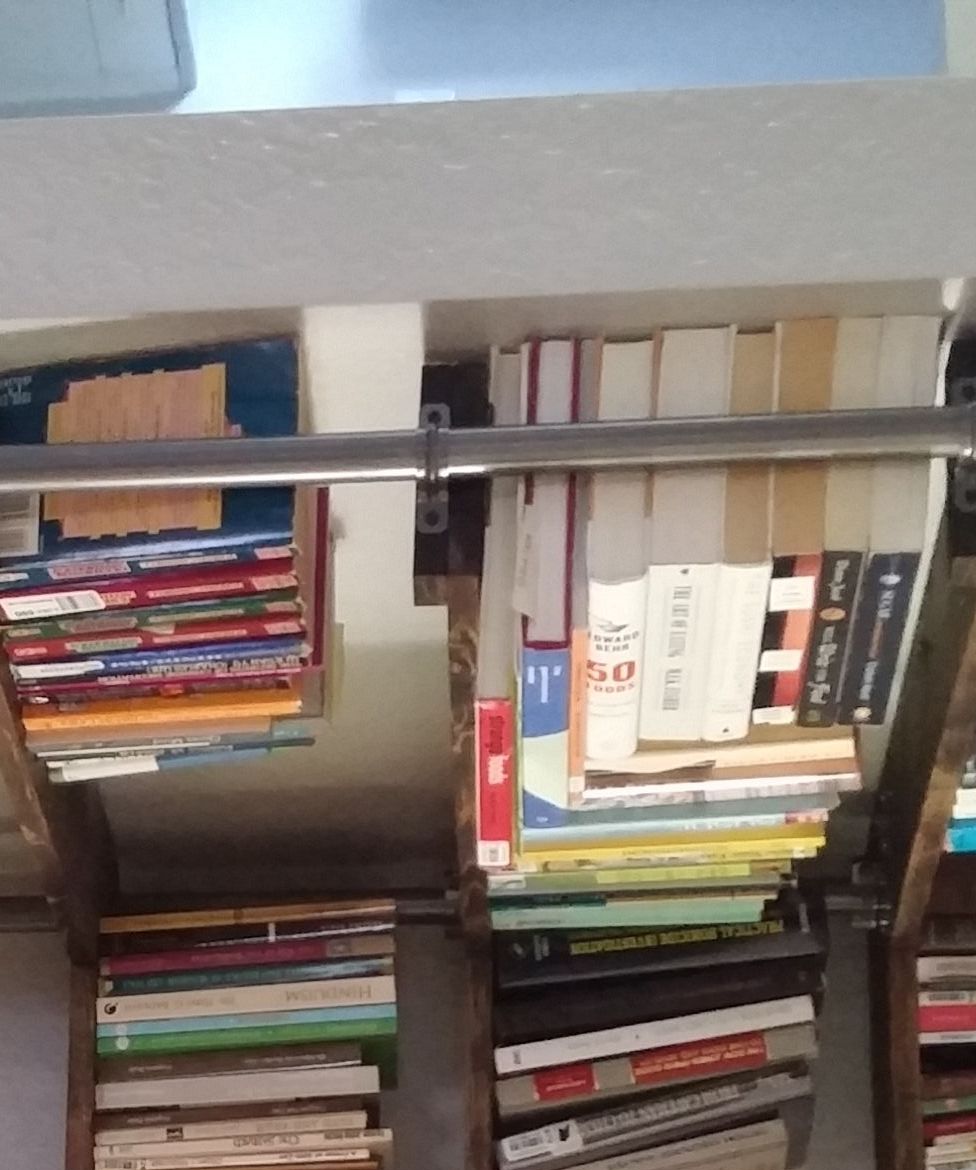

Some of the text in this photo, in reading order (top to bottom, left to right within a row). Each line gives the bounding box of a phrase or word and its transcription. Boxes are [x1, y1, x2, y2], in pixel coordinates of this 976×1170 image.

[586, 660, 635, 682] 50
[586, 682, 635, 693] OODS
[720, 919, 784, 938] PRACTICAL
[285, 985, 372, 1001] HINDUISM
